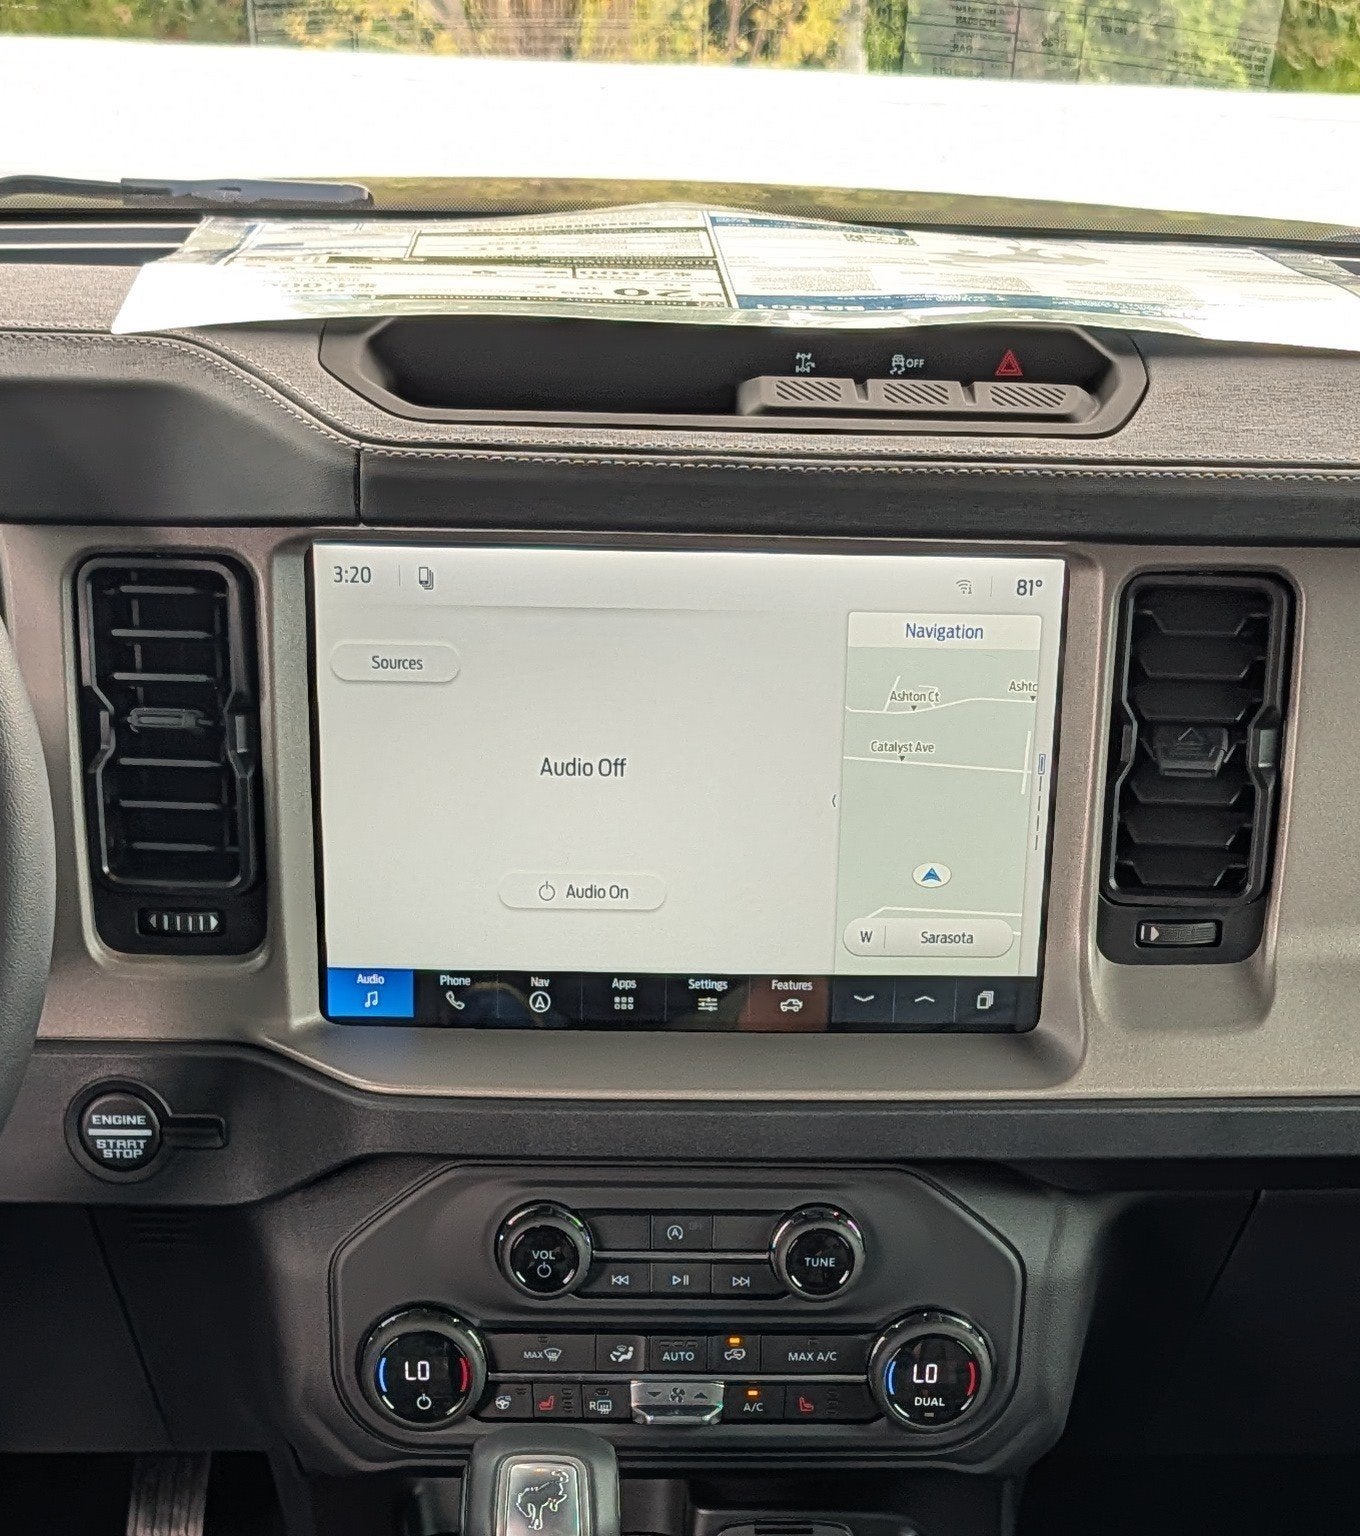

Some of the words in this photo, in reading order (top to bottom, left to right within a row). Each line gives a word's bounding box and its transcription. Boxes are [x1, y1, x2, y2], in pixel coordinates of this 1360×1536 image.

[906, 358, 925, 368] OFF
[333, 565, 372, 584] 3:20
[1016, 578, 1043, 597] 81°
[905, 623, 984, 641] Navigation
[371, 655, 424, 670] Sources
[890, 691, 926, 702] Ashton
[928, 692, 940, 703] Ct
[870, 740, 913, 754] Catalyst
[914, 741, 935, 753] Ave
[540, 757, 594, 778] Audio
[598, 757, 628, 778] Off
[565, 883, 606, 901] Audio
[609, 884, 629, 901] On
[859, 930, 874, 944] W
[920, 930, 975, 946] Sarasota
[356, 973, 385, 986] Audio
[439, 974, 471, 987] Phone
[530, 976, 550, 988] Nav
[611, 978, 637, 992] Apps
[688, 978, 729, 993] Settings
[771, 979, 813, 991] Features
[92, 1114, 147, 1126] ENGINE
[96, 1139, 148, 1149] START
[102, 1149, 144, 1159] STOP
[532, 1250, 555, 1261] VOL
[805, 1257, 836, 1268] TUNE
[523, 1351, 543, 1359] MAX
[662, 1351, 695, 1362] AUTO
[788, 1352, 815, 1362] MAX
[817, 1351, 838, 1363] A/C
[404, 1360, 430, 1381] LO
[912, 1363, 938, 1384] LO
[743, 1402, 764, 1412] A/C
[914, 1397, 945, 1407] DUAL
